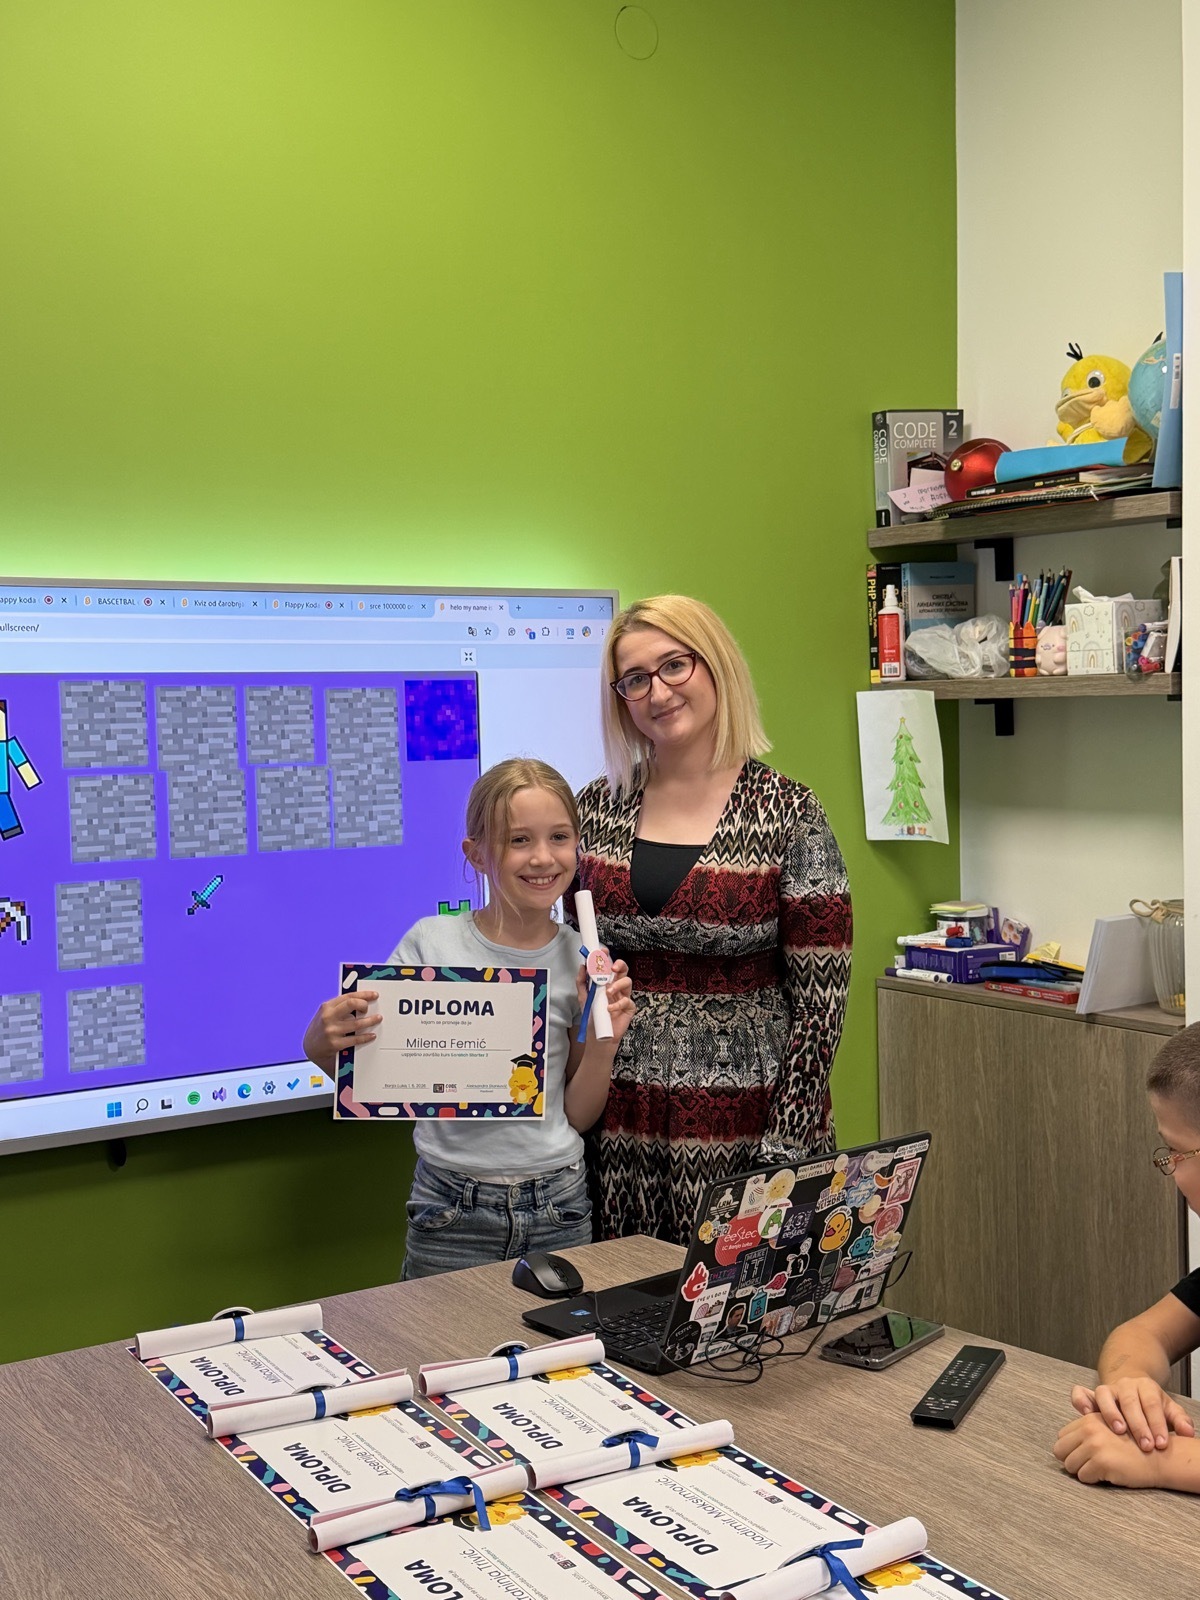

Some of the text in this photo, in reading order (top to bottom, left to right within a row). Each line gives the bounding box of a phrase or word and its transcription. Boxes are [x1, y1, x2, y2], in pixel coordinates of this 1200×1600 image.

[894, 422, 937, 439] CODE
[894, 439, 936, 449] COMPLETE
[949, 420, 958, 436] 2
[878, 429, 888, 464] CODE
[284, 602, 304, 610] Flappy
[868, 578, 877, 600] PHP
[398, 998, 494, 1016] DIPLOMA
[406, 1038, 486, 1048] Milena Femić
[190, 1356, 244, 1396] DIPLOMA
[492, 1402, 564, 1450] DIPLOMA
[282, 1442, 351, 1494] DIPLOMA
[655, 1477, 726, 1519] Maksimović
[622, 1496, 719, 1556] DIPLOMA
[717, 1515, 774, 1550] Vladimir
[404, 1559, 464, 1600] LOMA
[459, 1548, 531, 1600] rahinja Trivić
